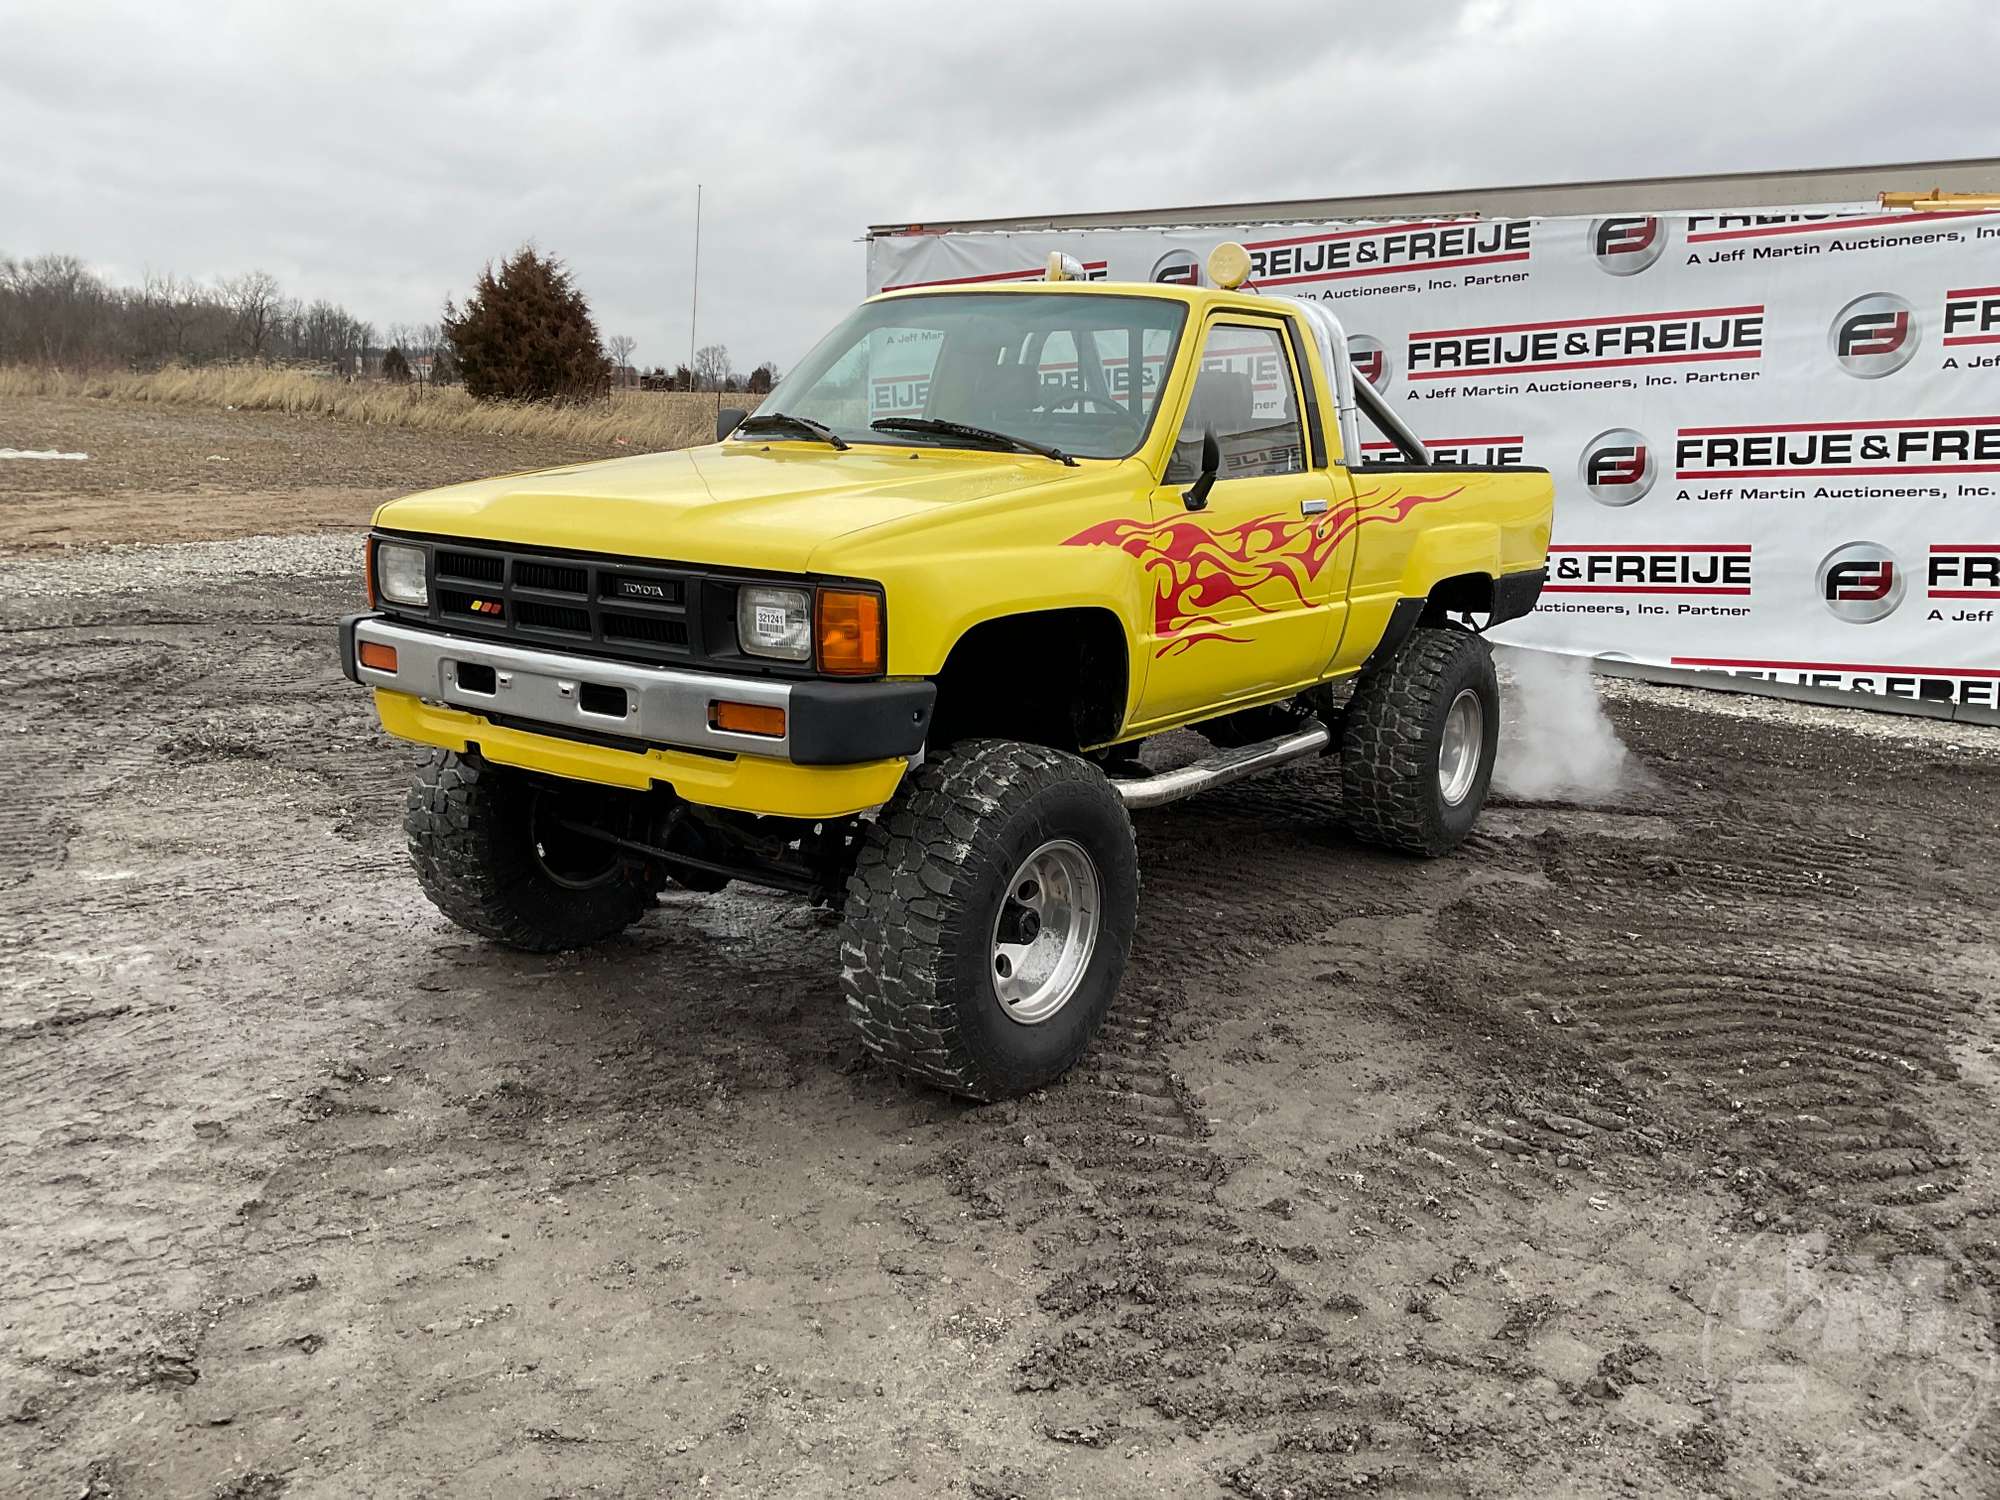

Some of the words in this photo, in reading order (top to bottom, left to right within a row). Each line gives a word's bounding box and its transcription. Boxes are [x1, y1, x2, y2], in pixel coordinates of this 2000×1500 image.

[1250, 242, 1350, 277] REIJE
[1383, 221, 1530, 263] FREIJE
[1687, 254, 1701, 265] A
[1708, 249, 1745, 263] Jeff
[1753, 243, 1820, 259] Martin
[1829, 232, 1965, 252] Auctioneers,
[1322, 284, 1421, 300] Auctioneers,
[1428, 279, 1457, 290] Inc.
[1464, 273, 1529, 286] Partner
[1408, 333, 1557, 370] FREIJE
[1595, 317, 1763, 357] FREIJE
[1942, 357, 1959, 369] A
[1407, 390, 1420, 400] A
[1426, 388, 1456, 399] Jeff
[1463, 384, 1519, 397] Martin
[1526, 378, 1637, 393] Auctioneers,
[1646, 375, 1677, 386] Inc.
[1686, 371, 1760, 383] Partner
[1676, 434, 1852, 468] FREIJE
[1676, 490, 1690, 500] A
[1698, 489, 1733, 500] Jeff
[1740, 487, 1805, 500] Martin
[1814, 486, 1947, 499] Auctioneers,
[1958, 485, 1996, 497] Inc.
[1588, 556, 1751, 583] FREIJE
[624, 582, 664, 597] TOYOTA
[759, 613, 783, 624] 321241
[1532, 603, 1629, 615] uctioneers,
[1638, 604, 1669, 615] Inc.
[1678, 604, 1751, 616] Partner
[1928, 610, 1943, 621] A
[1952, 610, 1994, 622] Jeff
